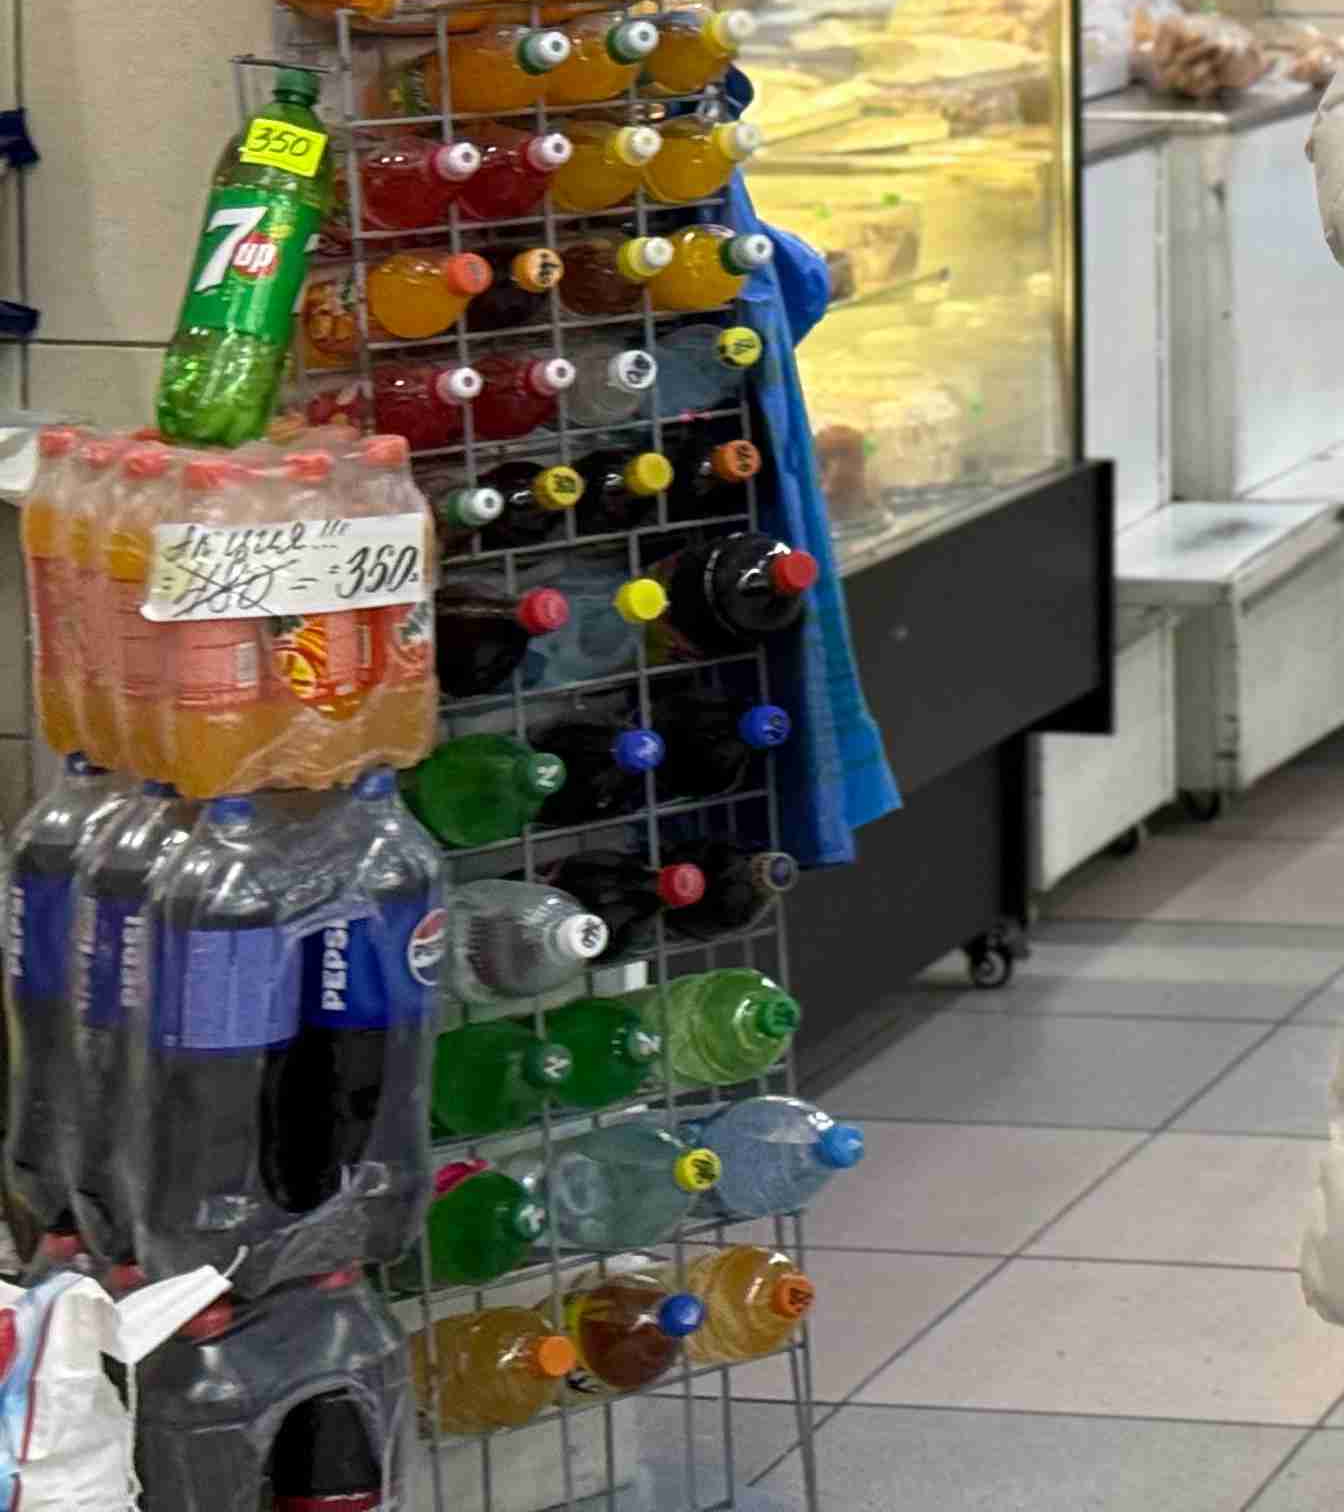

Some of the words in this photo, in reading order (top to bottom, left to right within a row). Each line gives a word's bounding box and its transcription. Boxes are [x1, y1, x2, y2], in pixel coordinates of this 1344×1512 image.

[250, 127, 313, 157] 350
[194, 206, 269, 292] 7
[233, 242, 277, 274] up
[320, 919, 349, 1011] PEPSI
